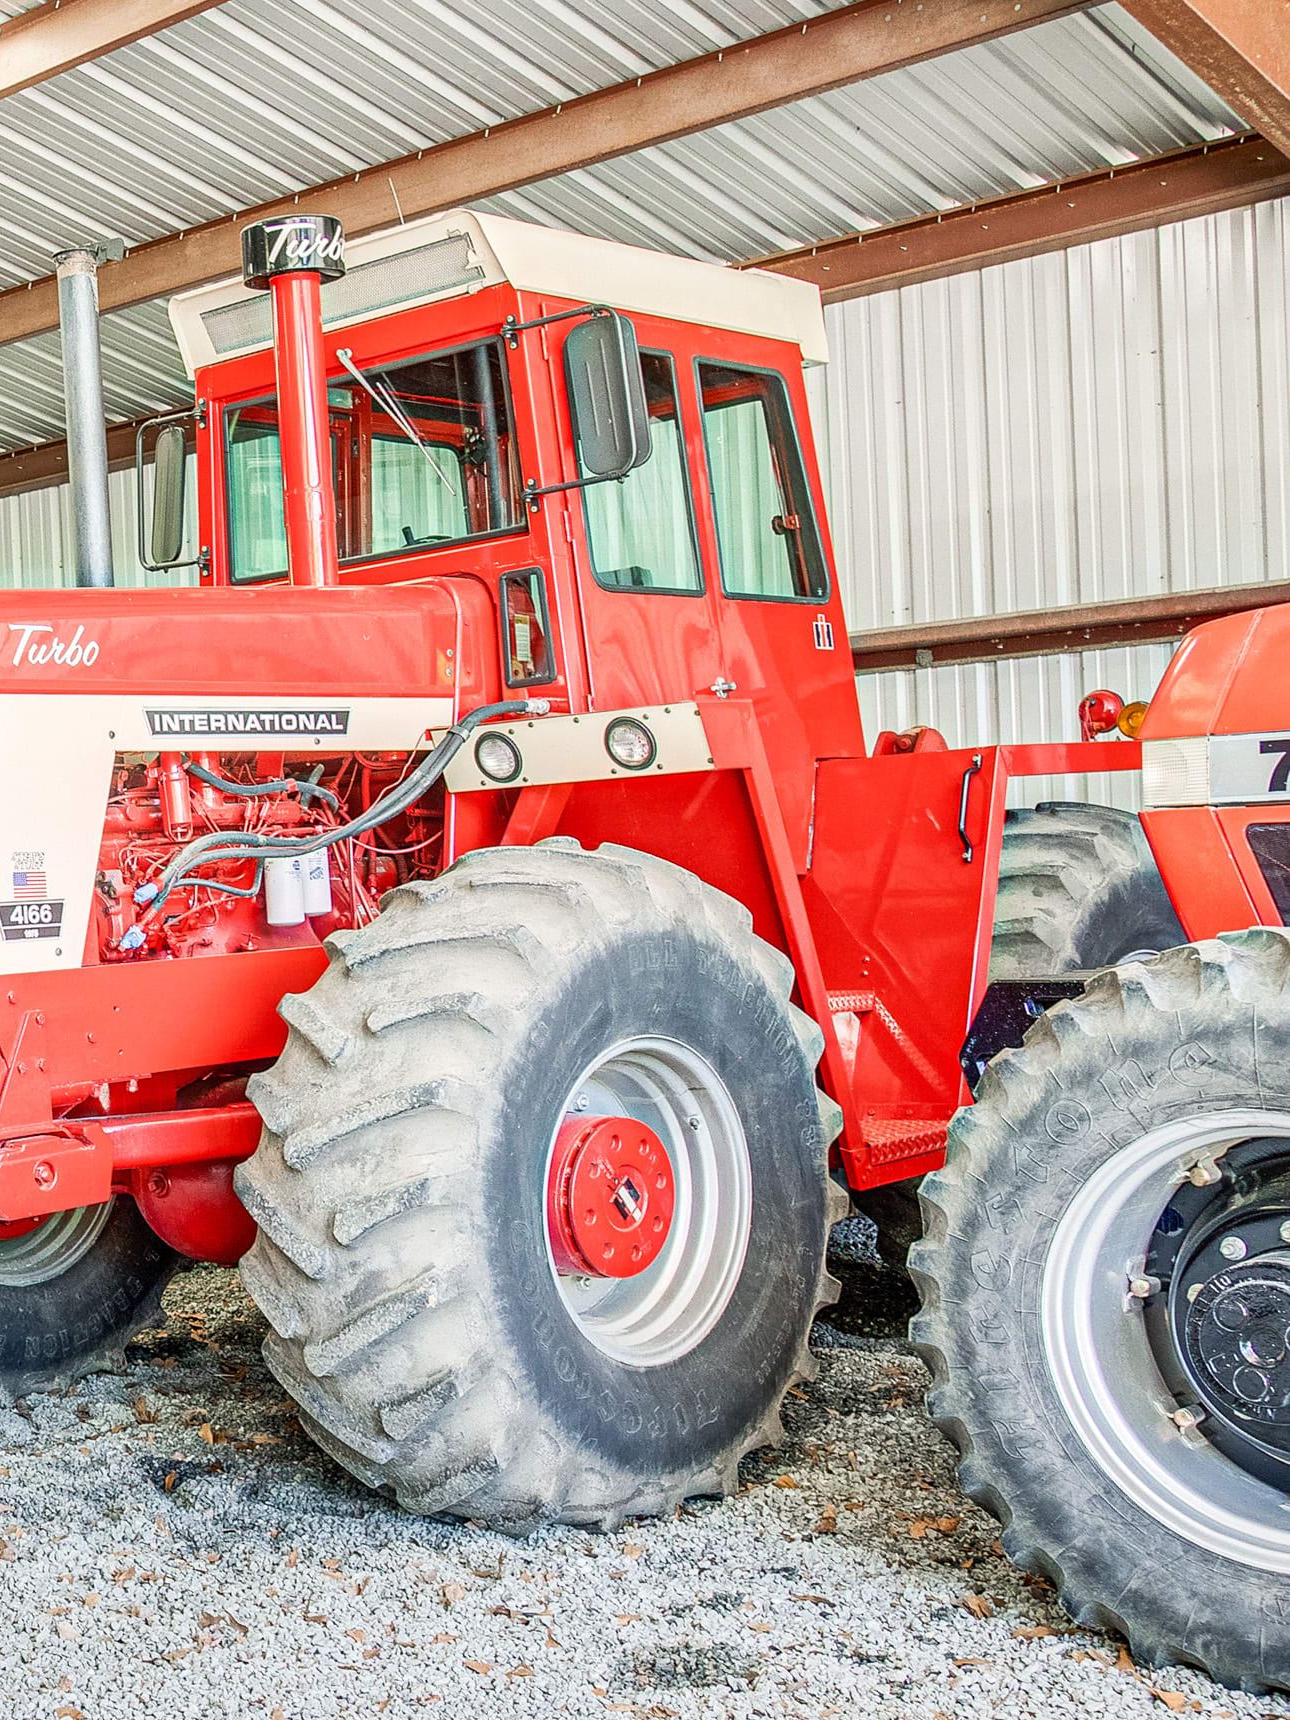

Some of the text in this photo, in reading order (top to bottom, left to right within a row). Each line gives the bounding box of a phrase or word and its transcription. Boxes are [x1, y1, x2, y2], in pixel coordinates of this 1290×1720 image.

[8, 623, 101, 668] Turbo
[153, 712, 344, 732] INTERNATIONAL
[10, 904, 53, 925] 4166
